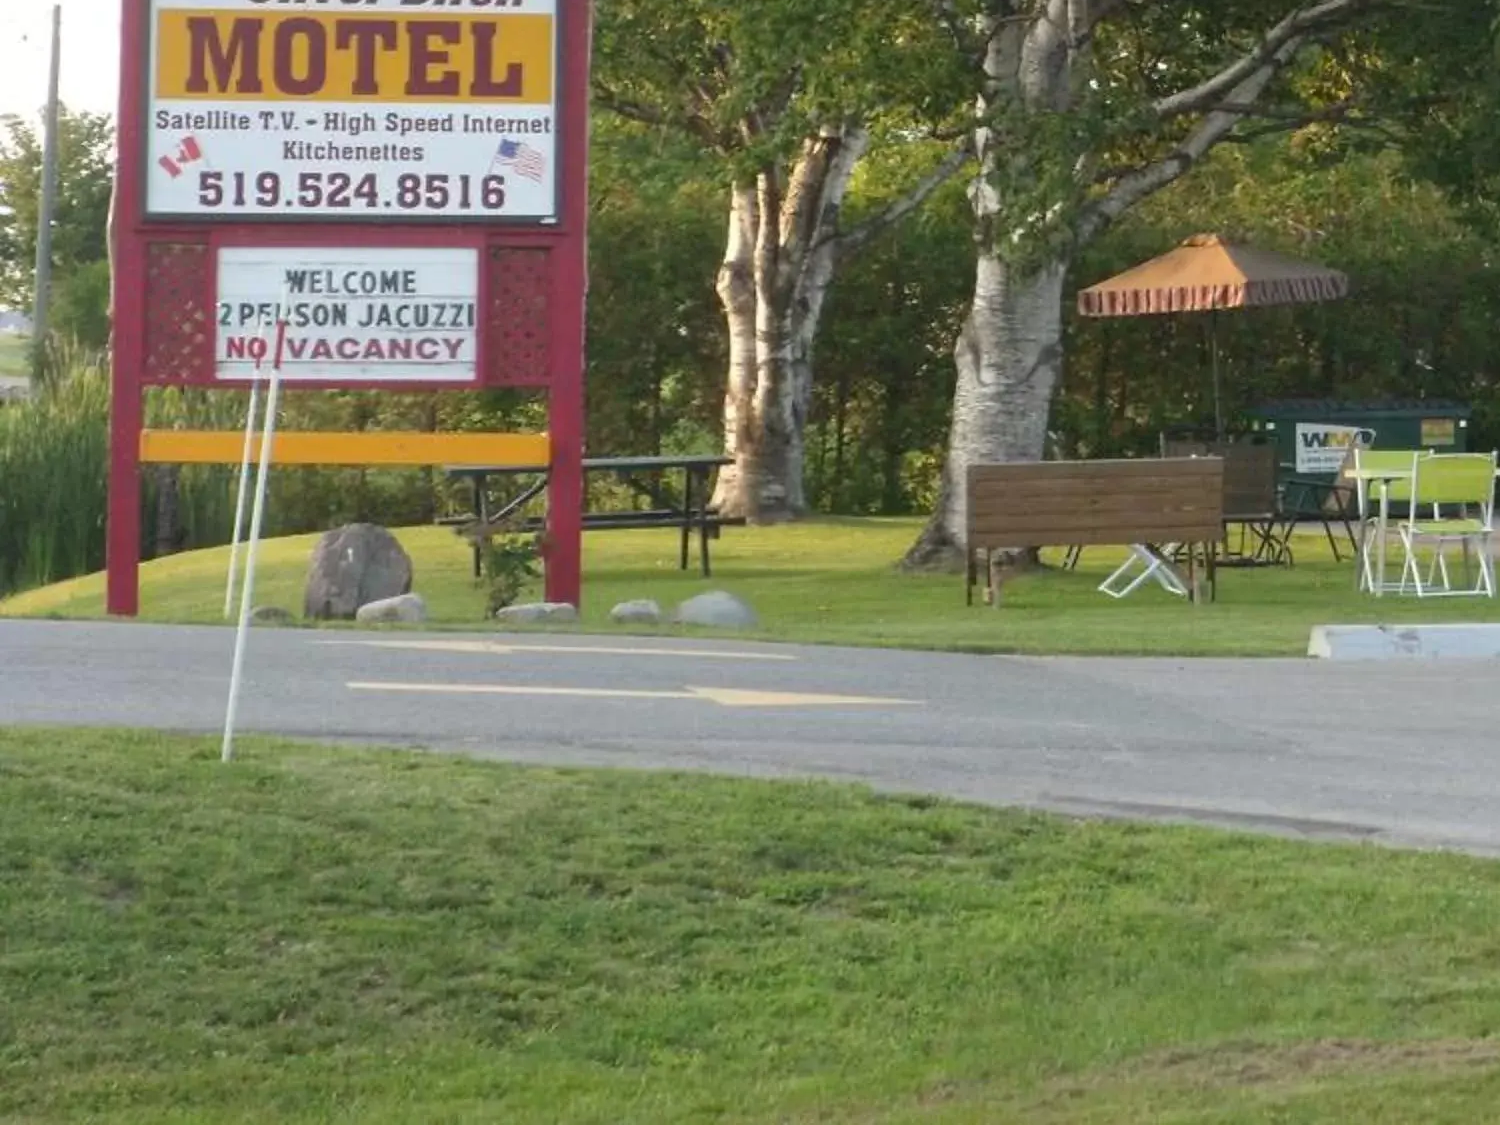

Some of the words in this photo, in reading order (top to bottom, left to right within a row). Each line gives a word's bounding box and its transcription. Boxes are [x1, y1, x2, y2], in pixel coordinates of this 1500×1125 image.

[185, 16, 523, 97] MOTEL
[156, 110, 250, 130] Satellite
[259, 111, 300, 131] T.V.
[324, 112, 375, 135] High
[385, 112, 453, 136] Speed
[463, 113, 551, 134] Internet
[283, 140, 424, 161] Kitchenettes
[199, 171, 505, 209] 519.524.8516
[285, 269, 417, 294] WELCOME
[219, 303, 232, 326] 2
[358, 303, 476, 327] JACUZZI
[227, 337, 268, 359] NO
[287, 337, 465, 360] VACANCY
